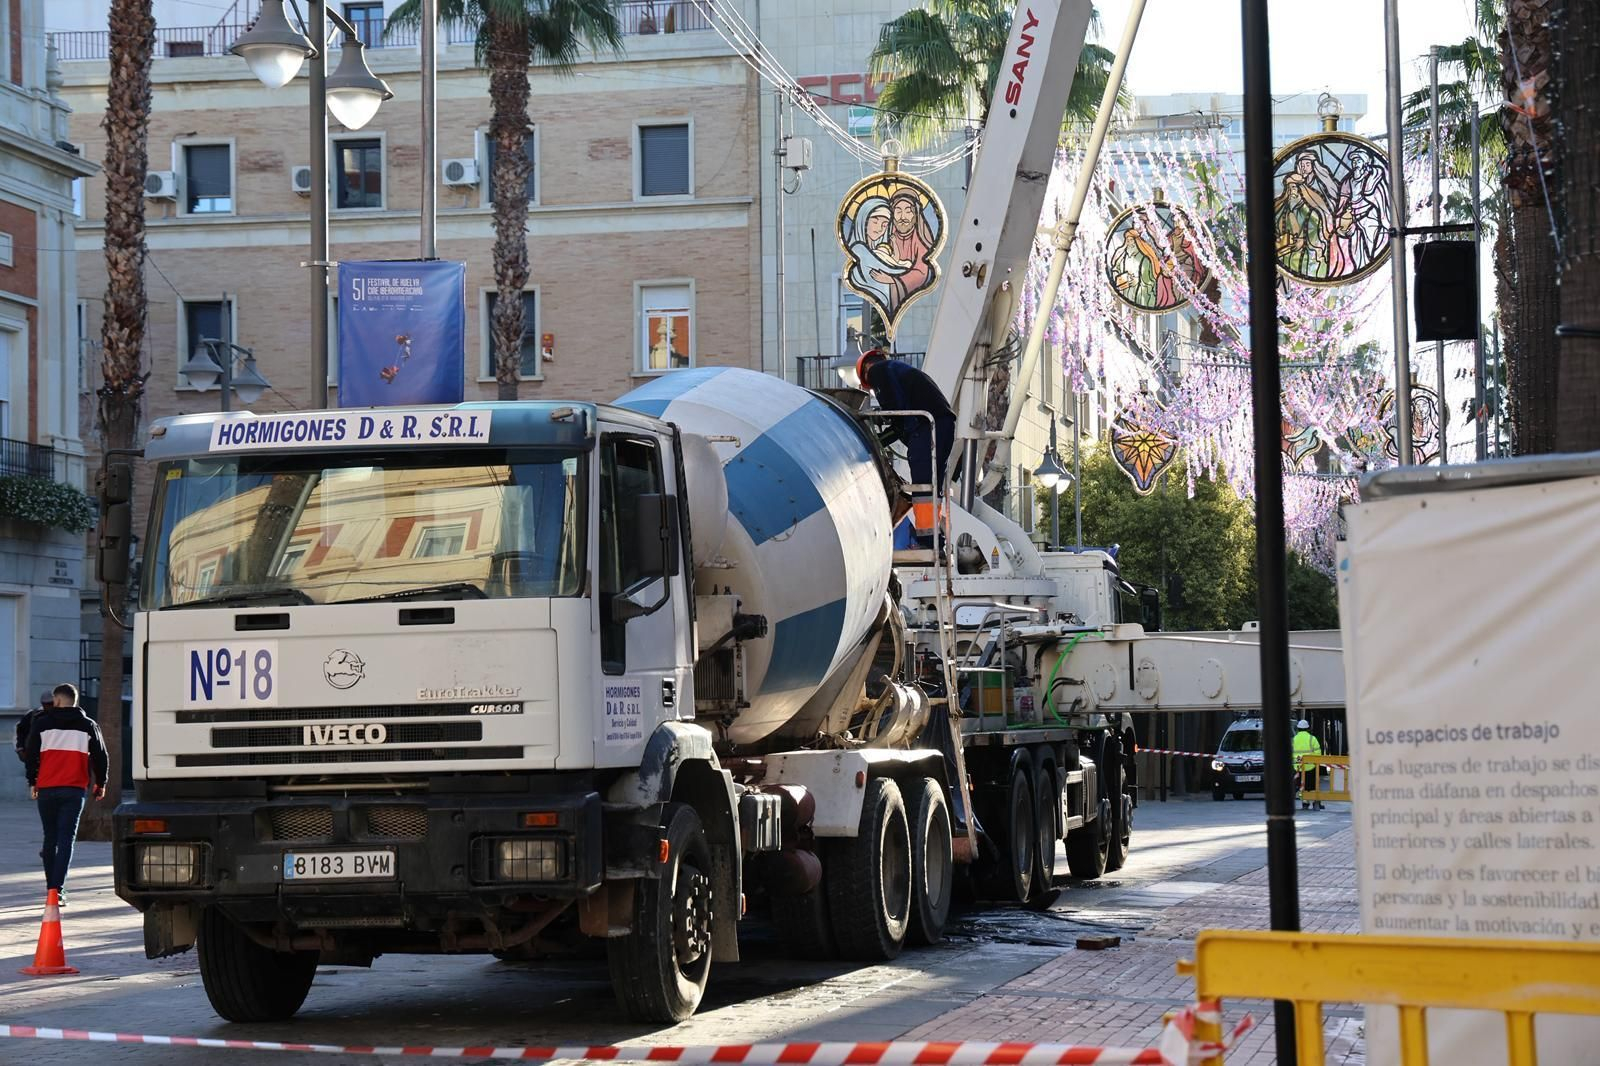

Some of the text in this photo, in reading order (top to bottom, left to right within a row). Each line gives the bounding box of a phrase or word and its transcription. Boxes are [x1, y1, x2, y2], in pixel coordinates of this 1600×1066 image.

[1005, 8, 1039, 106] SANY
[352, 278, 365, 301] 51
[367, 278, 420, 287] FESTIVAL DE HUELVA
[367, 287, 423, 295] CINE IBEROAMERICANO
[218, 418, 347, 446] HORMIGONES
[357, 416, 375, 439] D
[380, 419, 394, 439] &
[429, 415, 484, 438] S.R.L.
[416, 685, 522, 701] EuroTrakker
[606, 687, 641, 698] HORMIGONES
[469, 704, 521, 714] CURSOR
[303, 723, 387, 746] IVECO
[1367, 722, 1561, 747] Los espacios de trabajo
[1368, 760, 1395, 776] Los
[1400, 759, 1457, 778] lugares
[1462, 757, 1483, 774] de
[1488, 756, 1548, 776] trabajo
[1552, 760, 1571, 772] se
[1369, 781, 1599, 801] forma diáfana en despachos
[1371, 807, 1440, 828] principal
[1444, 811, 1454, 828] y
[1459, 808, 1503, 823] áreas
[1508, 807, 1576, 823] abiertas
[1581, 810, 1593, 823] a
[1372, 832, 1596, 852] interiores y calles laterales.
[295, 856, 344, 875] 8183
[353, 855, 390, 874] BVM
[1373, 864, 1386, 881] El
[1392, 864, 1451, 884] objetivo
[1457, 868, 1475, 881] es
[1480, 865, 1559, 882] favorecer
[1565, 865, 1580, 883] el
[1373, 890, 1600, 909] personas y la sostenibilidad
[1374, 915, 1450, 931] aumentar
[1455, 915, 1470, 932] la
[1475, 916, 1566, 935] motivación
[1571, 921, 1583, 939] y
